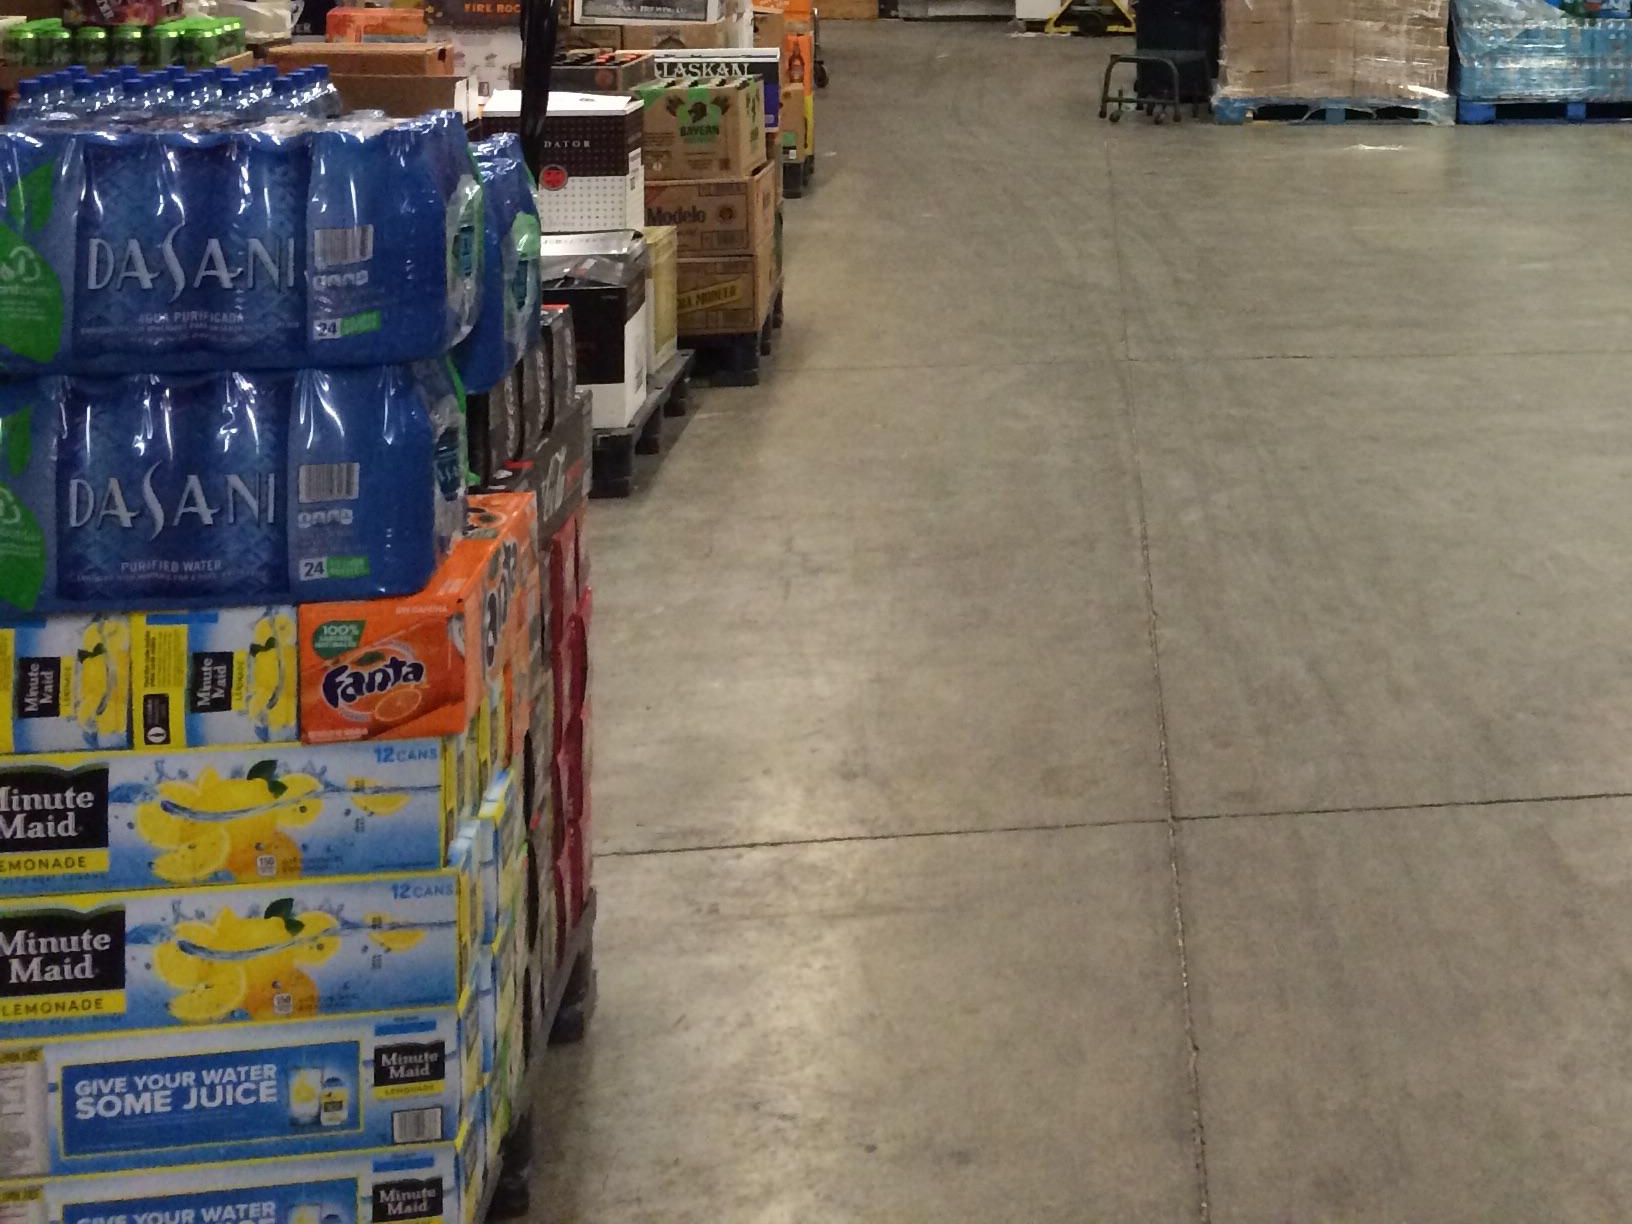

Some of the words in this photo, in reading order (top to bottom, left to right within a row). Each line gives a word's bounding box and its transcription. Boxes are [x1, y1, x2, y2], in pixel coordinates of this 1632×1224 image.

[464, 3, 493, 13] FIRE
[496, 4, 521, 14] ROC
[544, 140, 591, 149] DATOR
[645, 206, 707, 226] Modelo
[87, 223, 295, 304] DASANI
[317, 322, 338, 336] 24
[68, 461, 275, 542] DASANI
[183, 560, 221, 572] WATER
[304, 561, 325, 576] 24
[323, 625, 359, 635] 100%
[24, 663, 39, 712] Minute
[40, 671, 53, 704] Maid
[197, 657, 213, 706] Minute
[213, 665, 227, 698] Maid
[322, 656, 425, 708] Fanta
[374, 747, 394, 763] 12
[396, 748, 438, 763] CANS
[0, 856, 87, 872] EMONADE
[391, 884, 411, 899] 12
[413, 884, 453, 898] CANS
[0, 929, 111, 956] Minute
[9, 954, 95, 983] Maid
[2, 998, 104, 1017] LEMONADE
[381, 1052, 439, 1066] Minute
[74, 1077, 127, 1096] GIVE
[133, 1071, 196, 1090] YOUR
[201, 1064, 277, 1085] WATER
[389, 1065, 430, 1079] Maid
[75, 1090, 172, 1119] SOME
[183, 1080, 277, 1109] JUICE
[379, 1189, 436, 1203] Minute
[133, 1208, 195, 1224] YOUR
[201, 1202, 276, 1223] WATER
[387, 1201, 428, 1216] Maid
